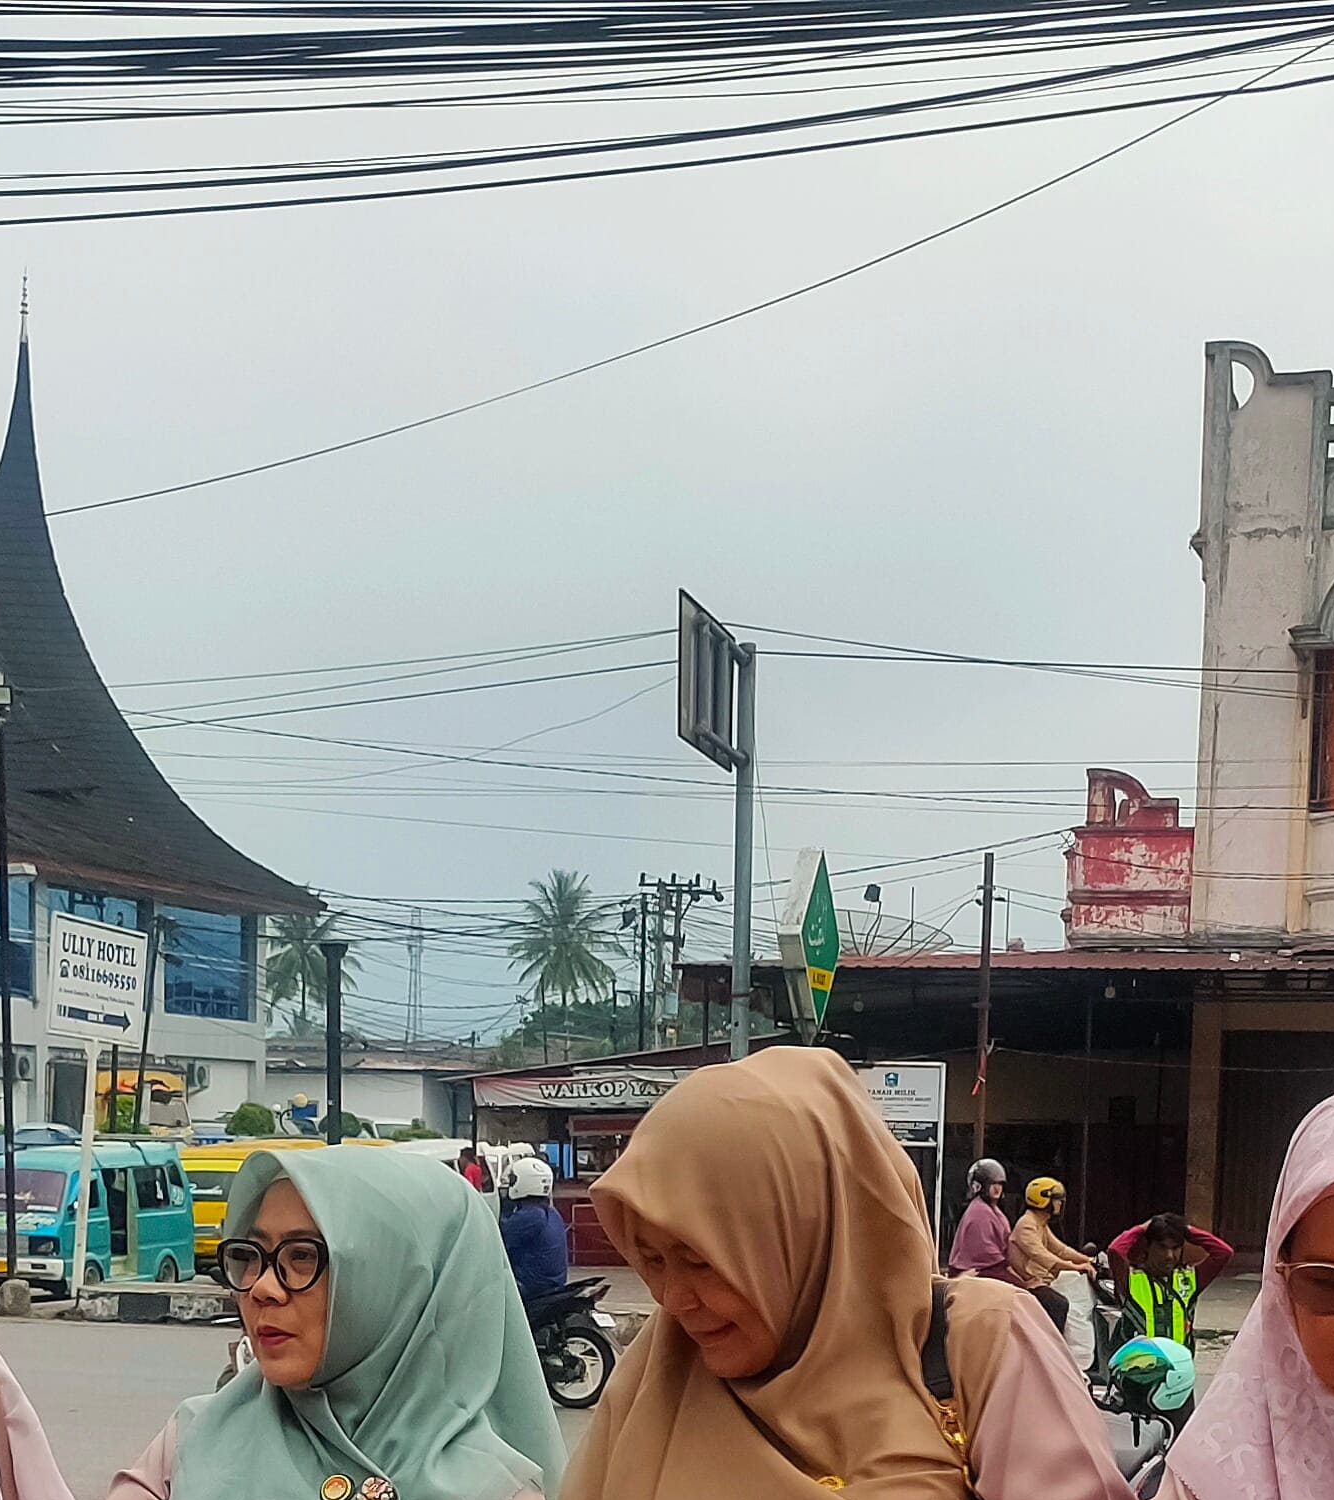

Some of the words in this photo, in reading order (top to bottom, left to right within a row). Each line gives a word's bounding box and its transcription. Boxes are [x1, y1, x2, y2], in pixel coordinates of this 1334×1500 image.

[62, 932, 95, 958] ULLY
[97, 940, 137, 967] HOTEL
[72, 962, 137, 991] 08116695550
[539, 1080, 627, 1099] WARKOP
